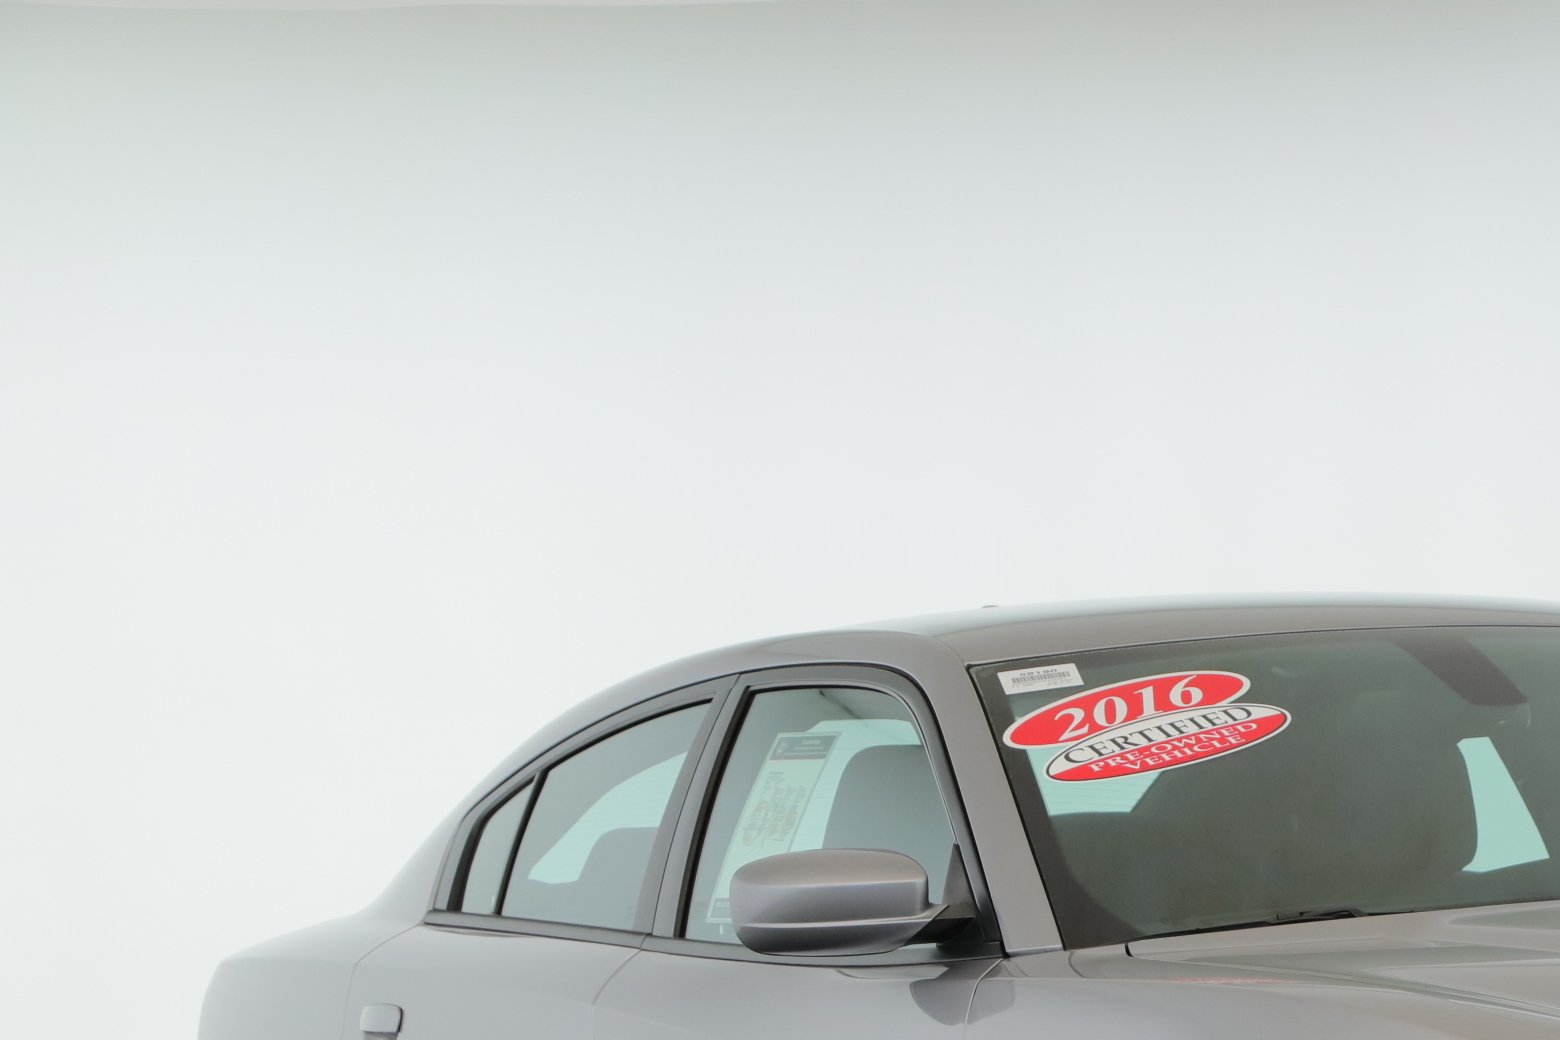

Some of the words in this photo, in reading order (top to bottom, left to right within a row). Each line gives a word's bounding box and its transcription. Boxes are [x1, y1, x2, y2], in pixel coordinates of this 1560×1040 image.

[1054, 674, 1203, 742] 2016
[1063, 705, 1254, 764] CERTIFIED
[1089, 721, 1258, 773] PRE-OWNED
[1125, 733, 1246, 770] VEHICLE
